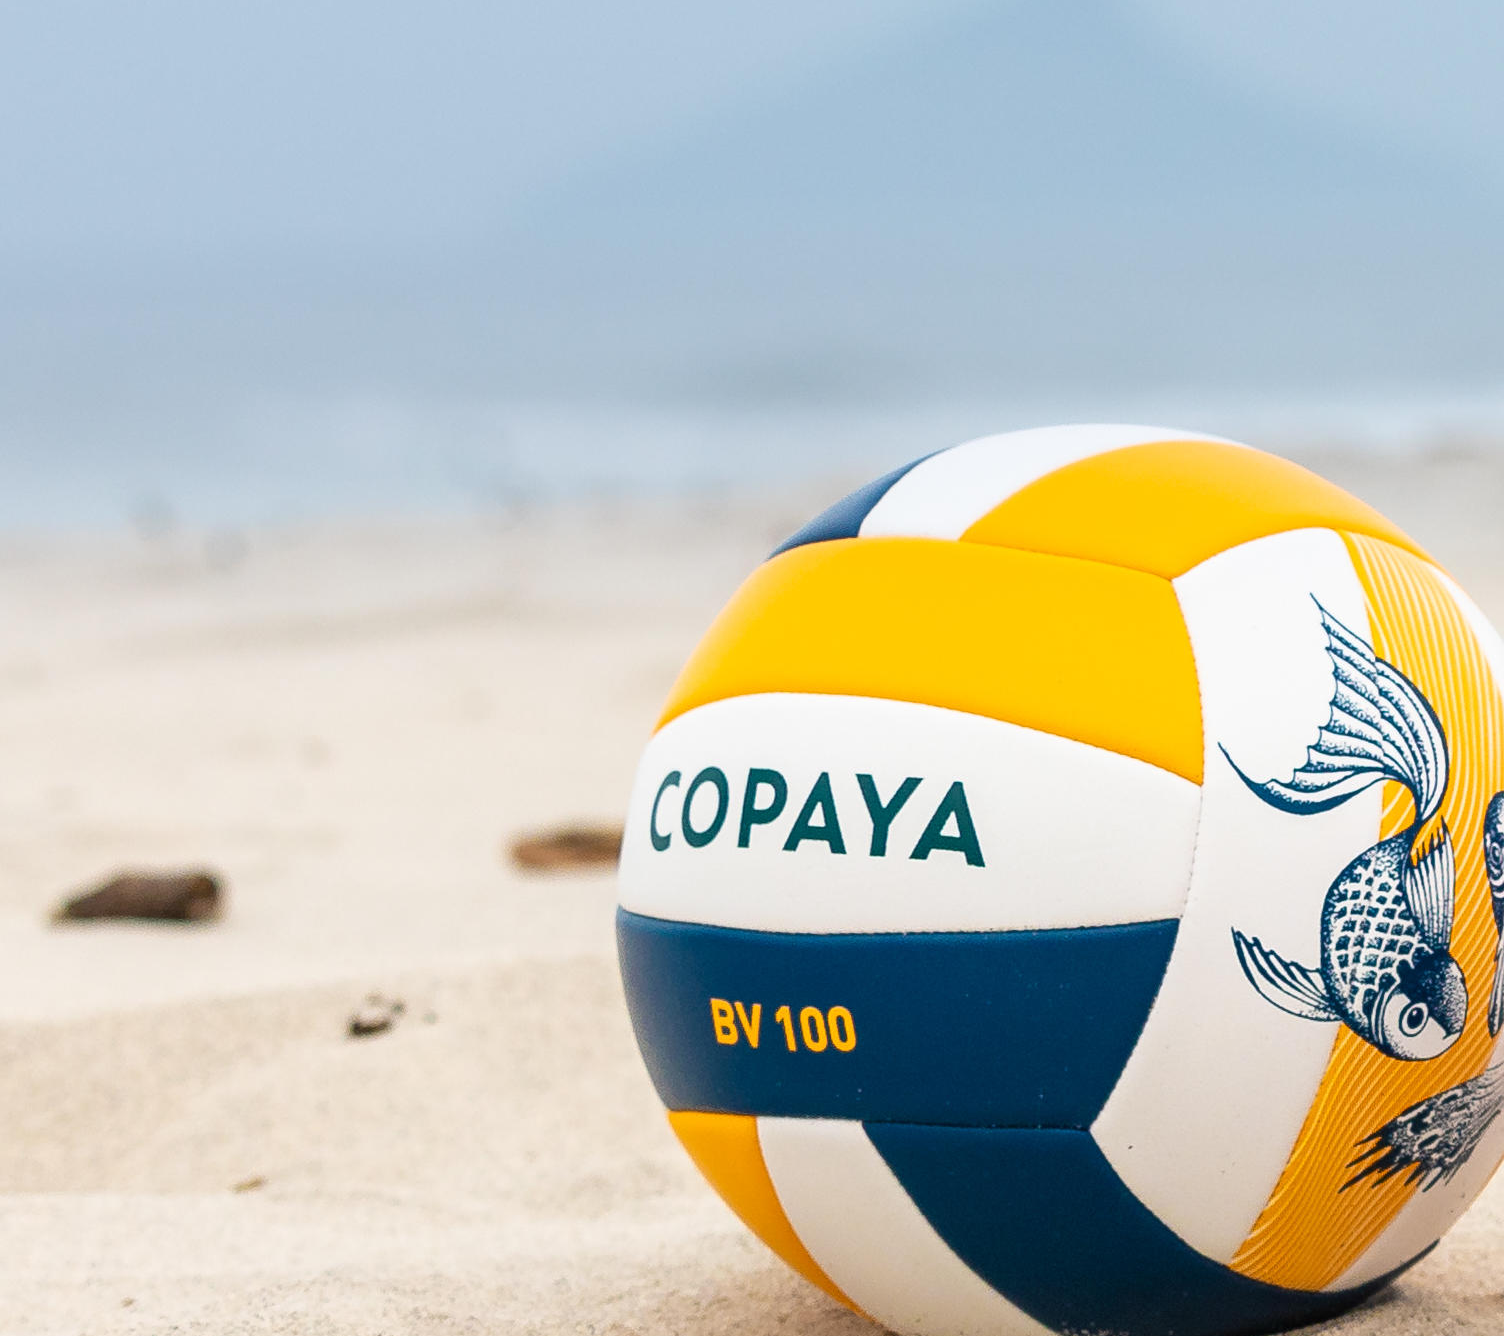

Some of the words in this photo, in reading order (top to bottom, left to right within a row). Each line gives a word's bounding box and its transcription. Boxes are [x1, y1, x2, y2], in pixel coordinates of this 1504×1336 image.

[650, 766, 986, 868] COPAYA
[710, 997, 762, 1048] BV
[775, 1005, 857, 1053] 100
